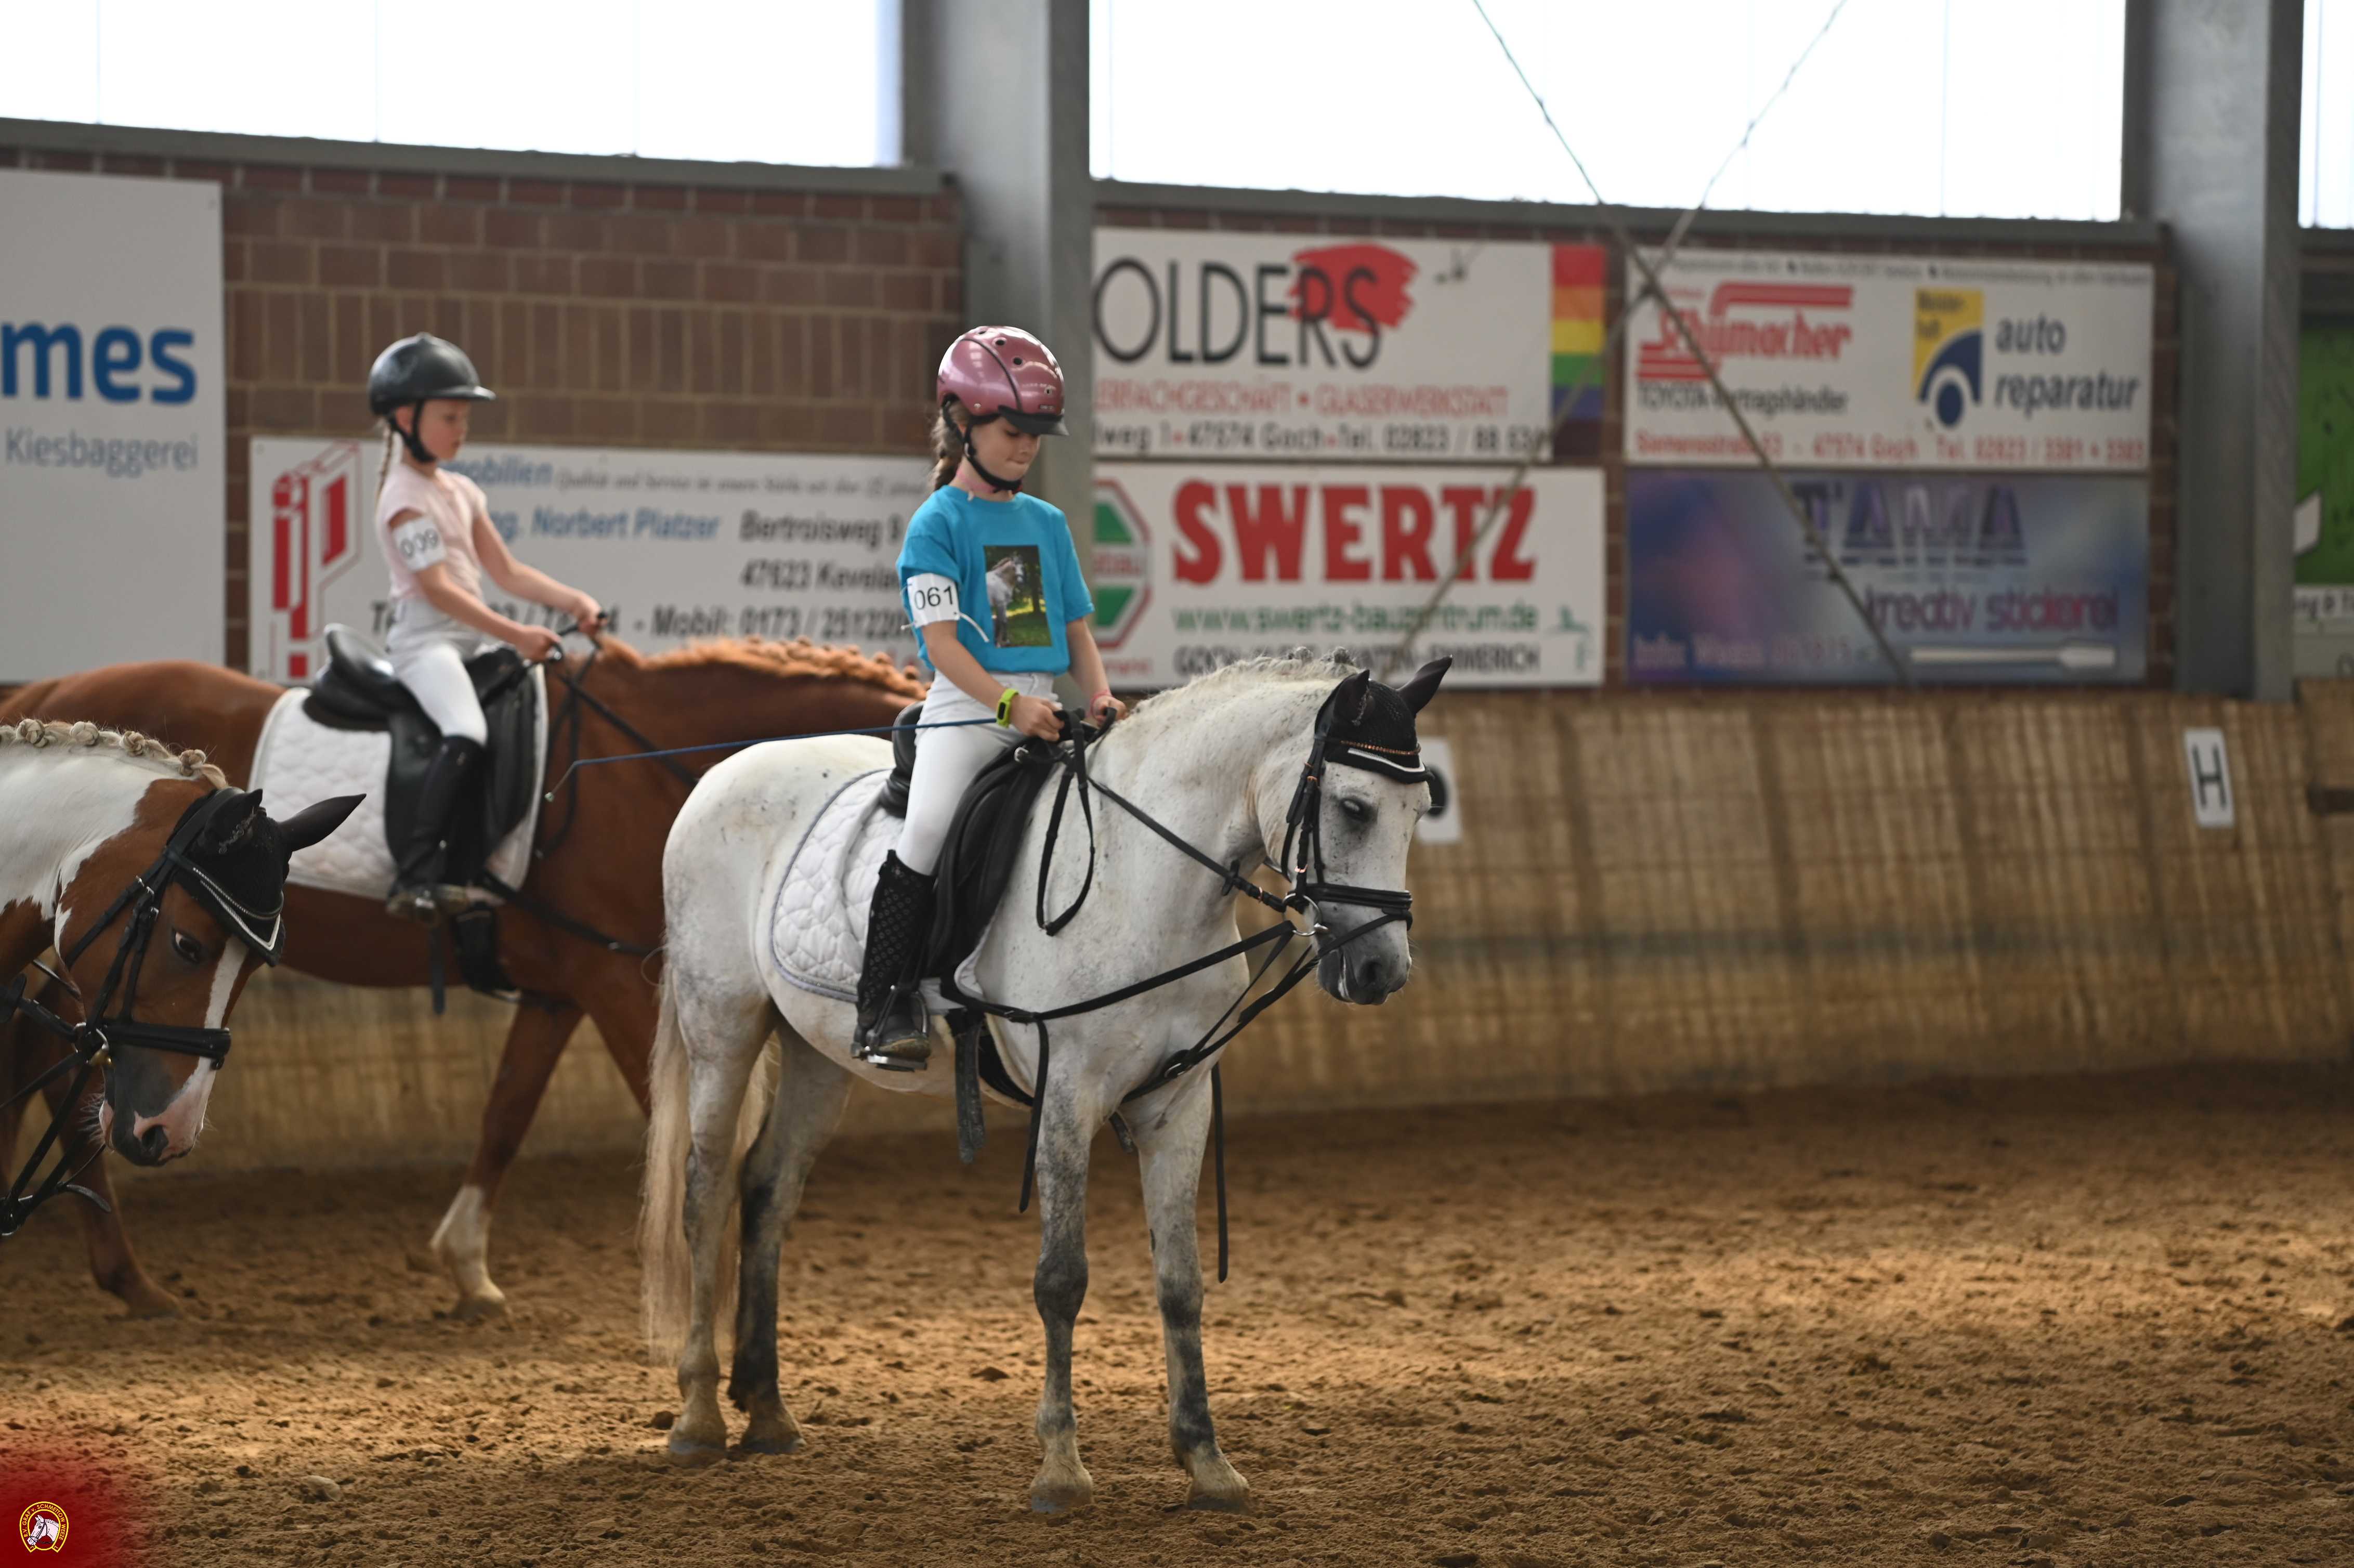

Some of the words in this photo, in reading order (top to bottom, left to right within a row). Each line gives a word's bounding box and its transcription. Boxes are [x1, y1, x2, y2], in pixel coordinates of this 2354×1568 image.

[1995, 313, 2066, 355] auto
[1, 321, 198, 404] mes
[1094, 377, 1291, 414] ERFACHGESCHÄFT
[1995, 369, 2140, 420] reparatur
[6, 427, 199, 477] Kiesbaggerei
[1188, 421, 1254, 449] 47574
[1260, 422, 1322, 450] Goch
[1385, 423, 1450, 451] 02823
[532, 505, 628, 539] Norbert
[633, 506, 722, 541] Platzer
[1172, 477, 1536, 585] SWERTZ
[815, 561, 901, 592] Kevela
[913, 585, 954, 610] 061
[652, 605, 732, 638] Mobil:
[1172, 600, 1538, 633] www.swertz-bauzntrum.de
[2192, 744, 2227, 810] H
